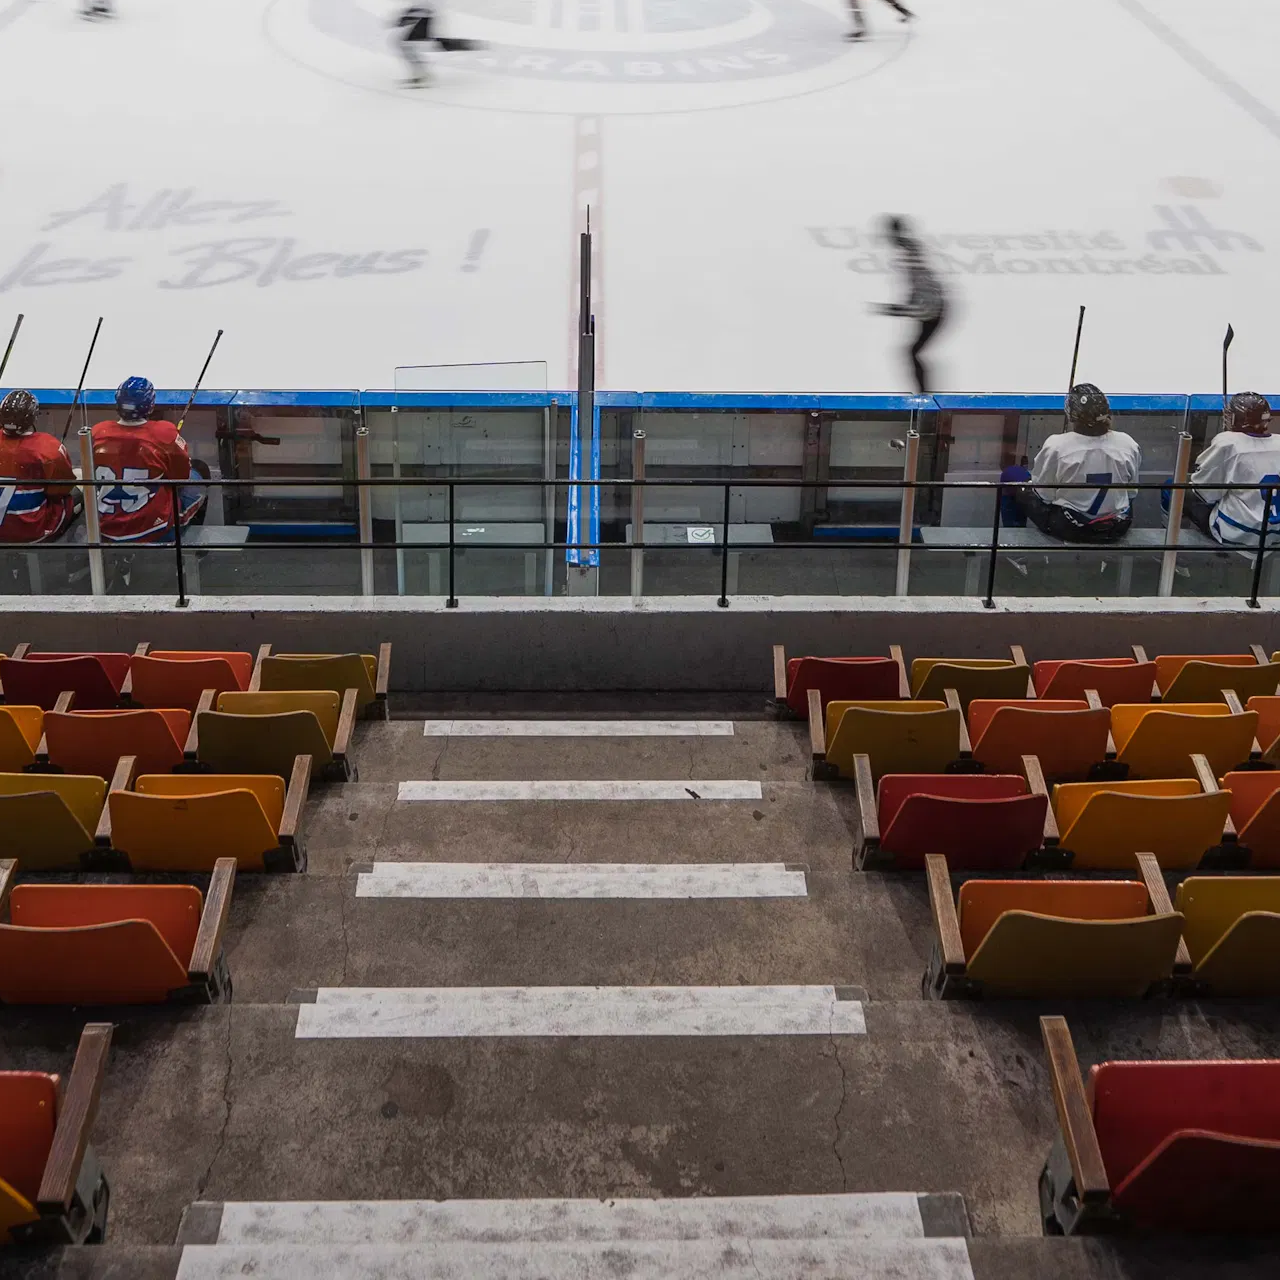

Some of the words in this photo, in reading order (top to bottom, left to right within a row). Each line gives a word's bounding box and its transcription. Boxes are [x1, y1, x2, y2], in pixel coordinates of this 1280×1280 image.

[40, 182, 292, 231] Allez
[156, 237, 430, 290] Bleus
[460, 227, 491, 274] !
[95, 466, 151, 513] 25
[1086, 473, 1113, 516] 7
